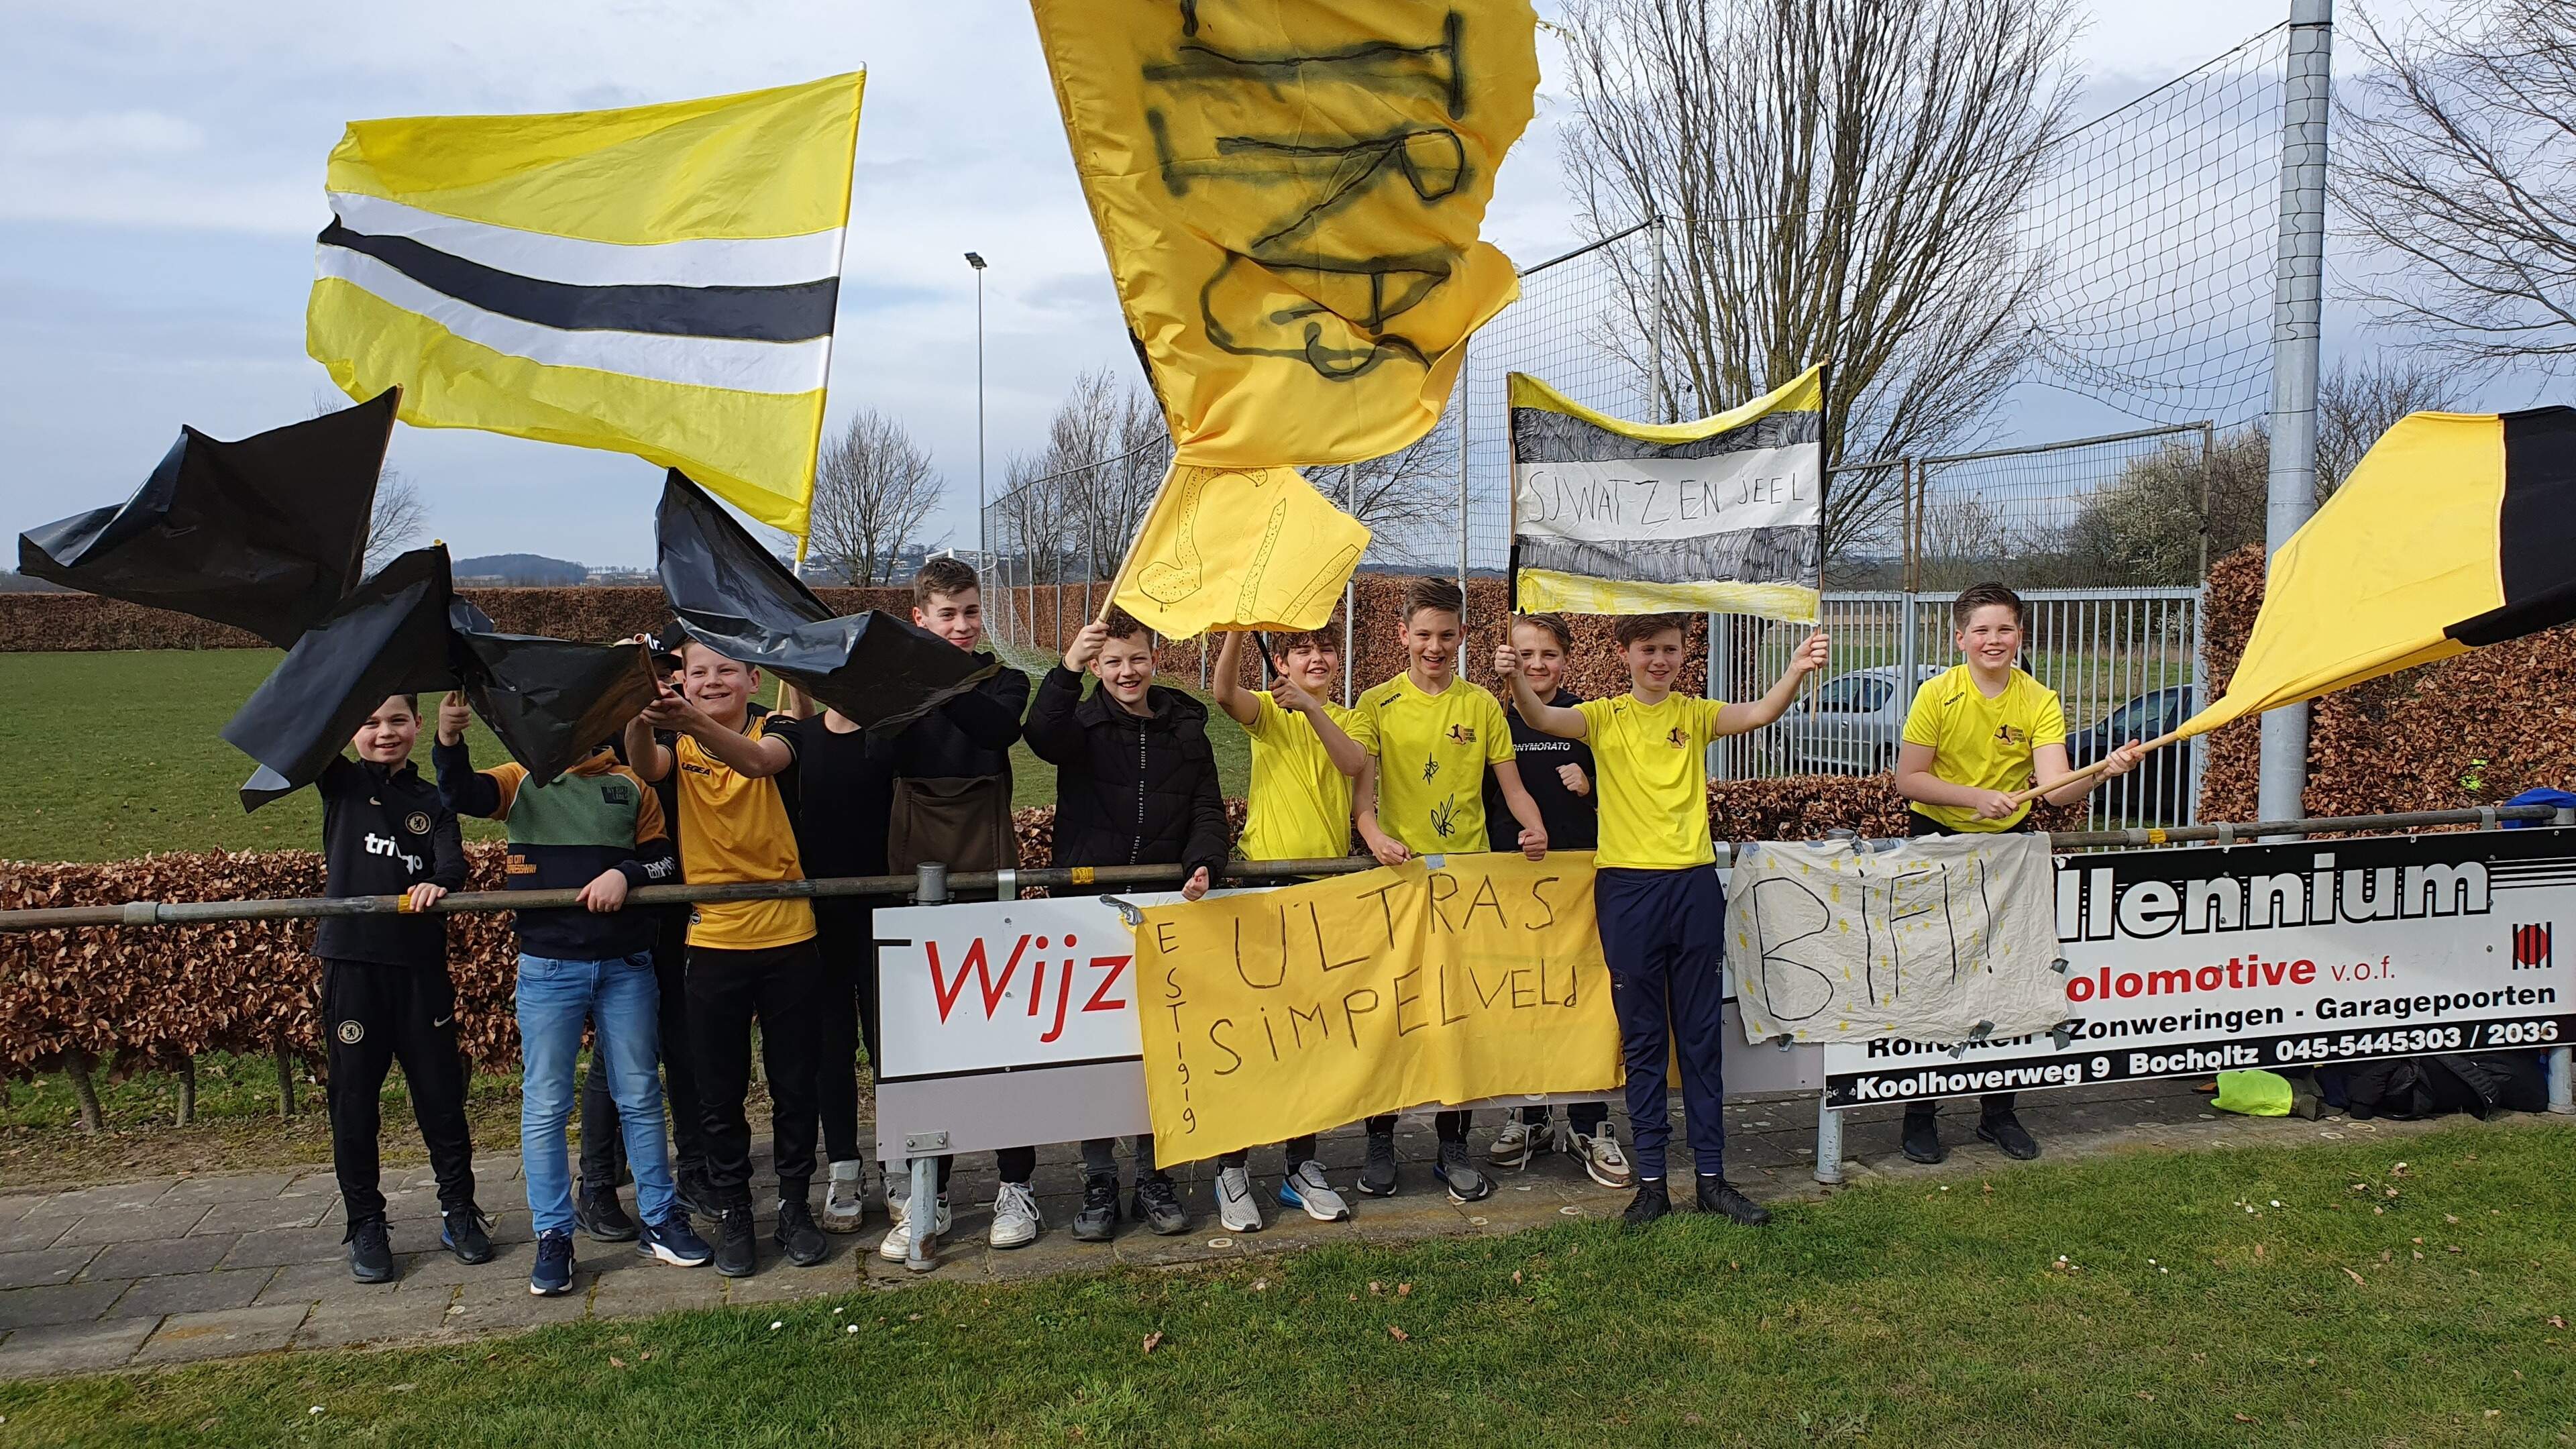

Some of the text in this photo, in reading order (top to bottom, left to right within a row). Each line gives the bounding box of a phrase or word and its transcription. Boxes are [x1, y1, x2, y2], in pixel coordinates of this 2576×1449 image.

[1680, 480, 1720, 520] EN
[1235, 873, 1559, 989] ULTRAS
[2055, 852, 2491, 943] llennium
[2065, 955, 2396, 1002] olomotive v.o.f.
[2069, 1006, 2284, 1040] Zonweringen
[2316, 985, 2557, 1020] Garagepoorten
[1857, 1063, 2082, 1100] Koolhoverweg
[2091, 1057, 2110, 1078] 9
[2129, 1045, 2259, 1075] Bocholtz
[2275, 1026, 2462, 1061] 045-5445303
[2487, 1020, 2559, 1044] 2036
